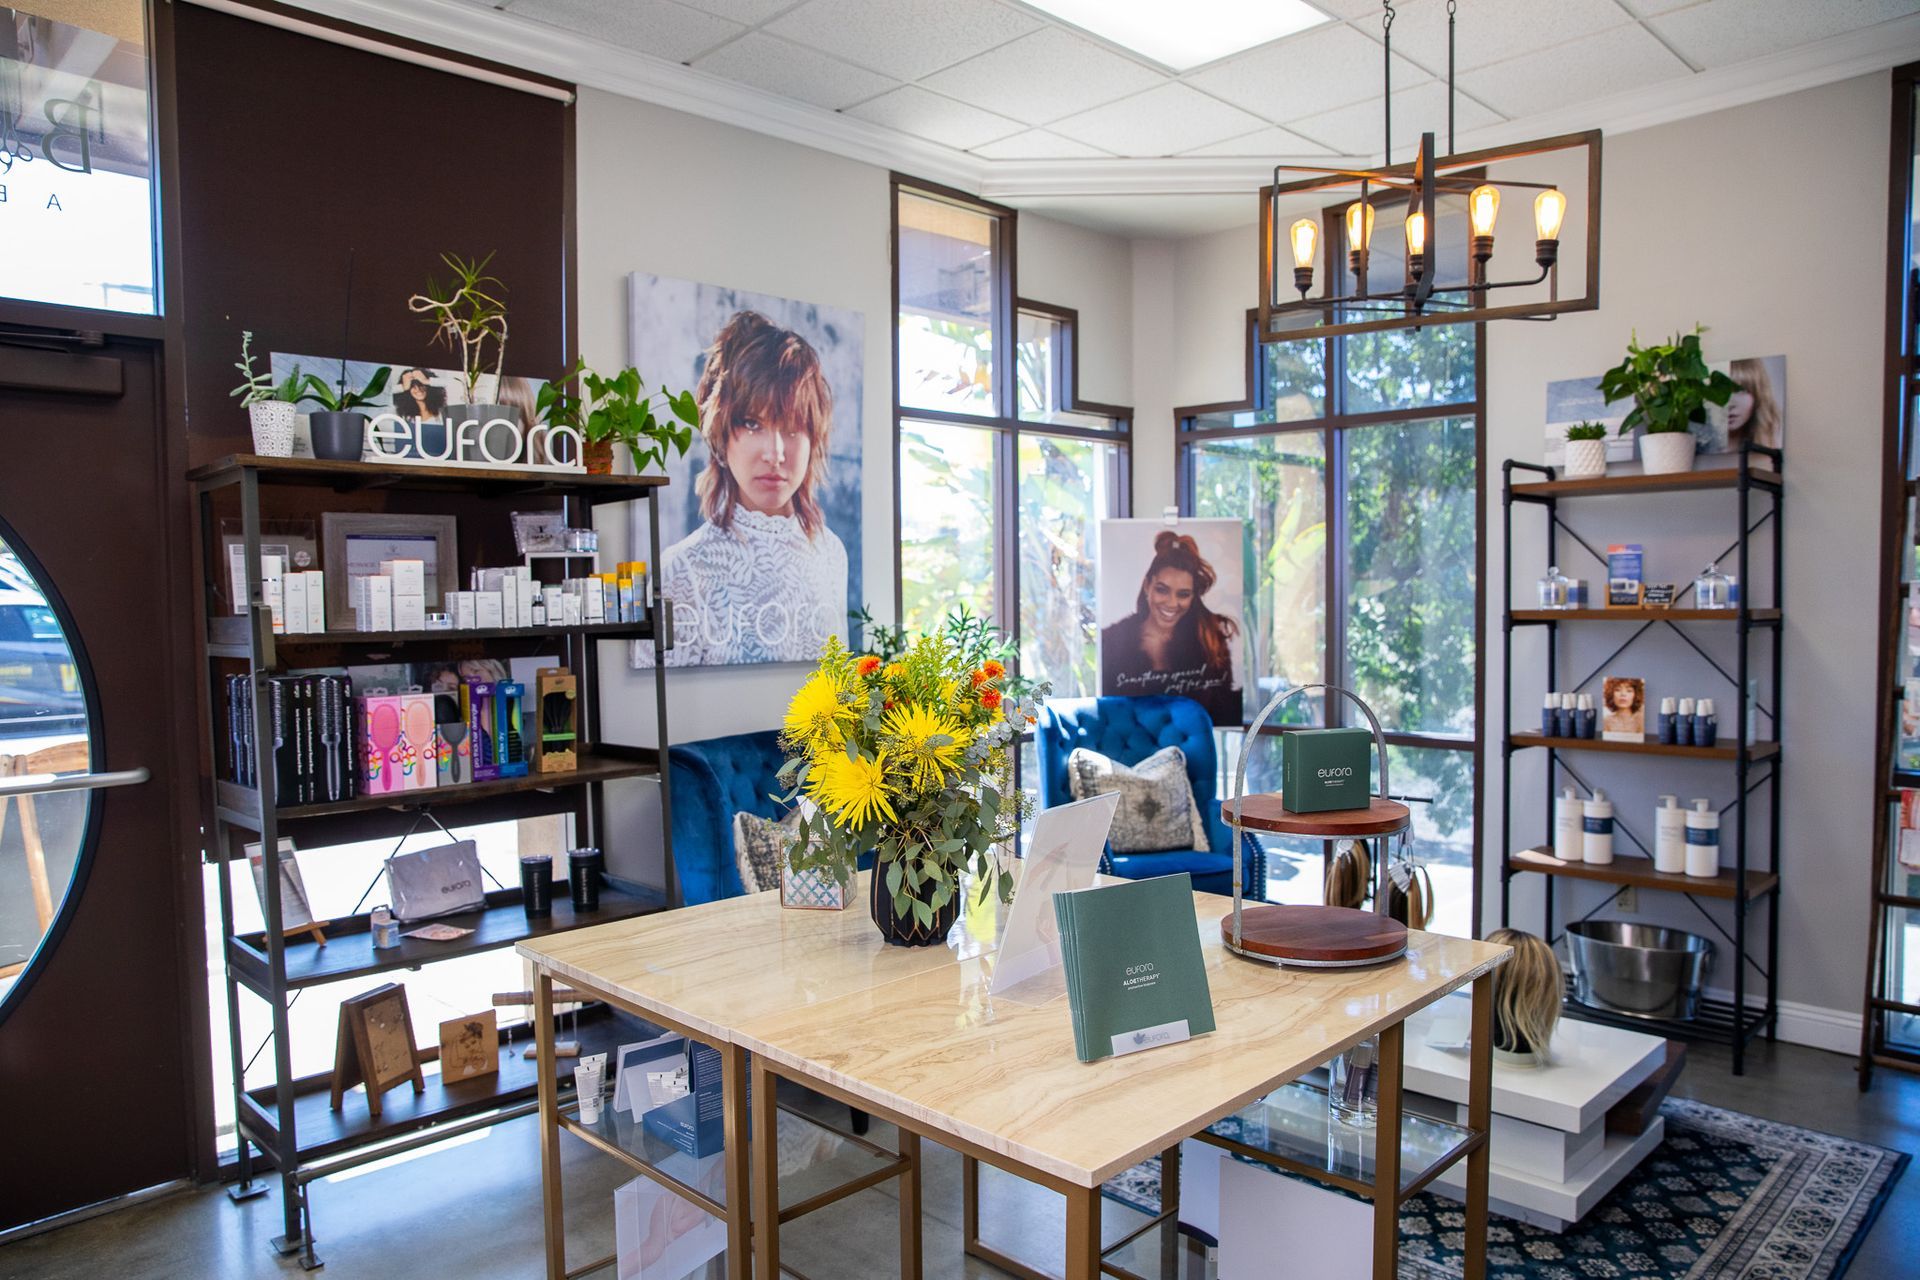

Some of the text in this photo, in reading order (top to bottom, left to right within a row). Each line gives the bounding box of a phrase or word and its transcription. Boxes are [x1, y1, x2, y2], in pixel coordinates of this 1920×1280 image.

[367, 413, 584, 468] eufora
[665, 602, 843, 646] eufora
[1117, 663, 1207, 687] Something special
[1164, 679, 1186, 694] just
[1187, 678, 1199, 691] for
[1317, 767, 1353, 778] eufora
[441, 879, 472, 894] eufora
[1126, 963, 1153, 976] eufora
